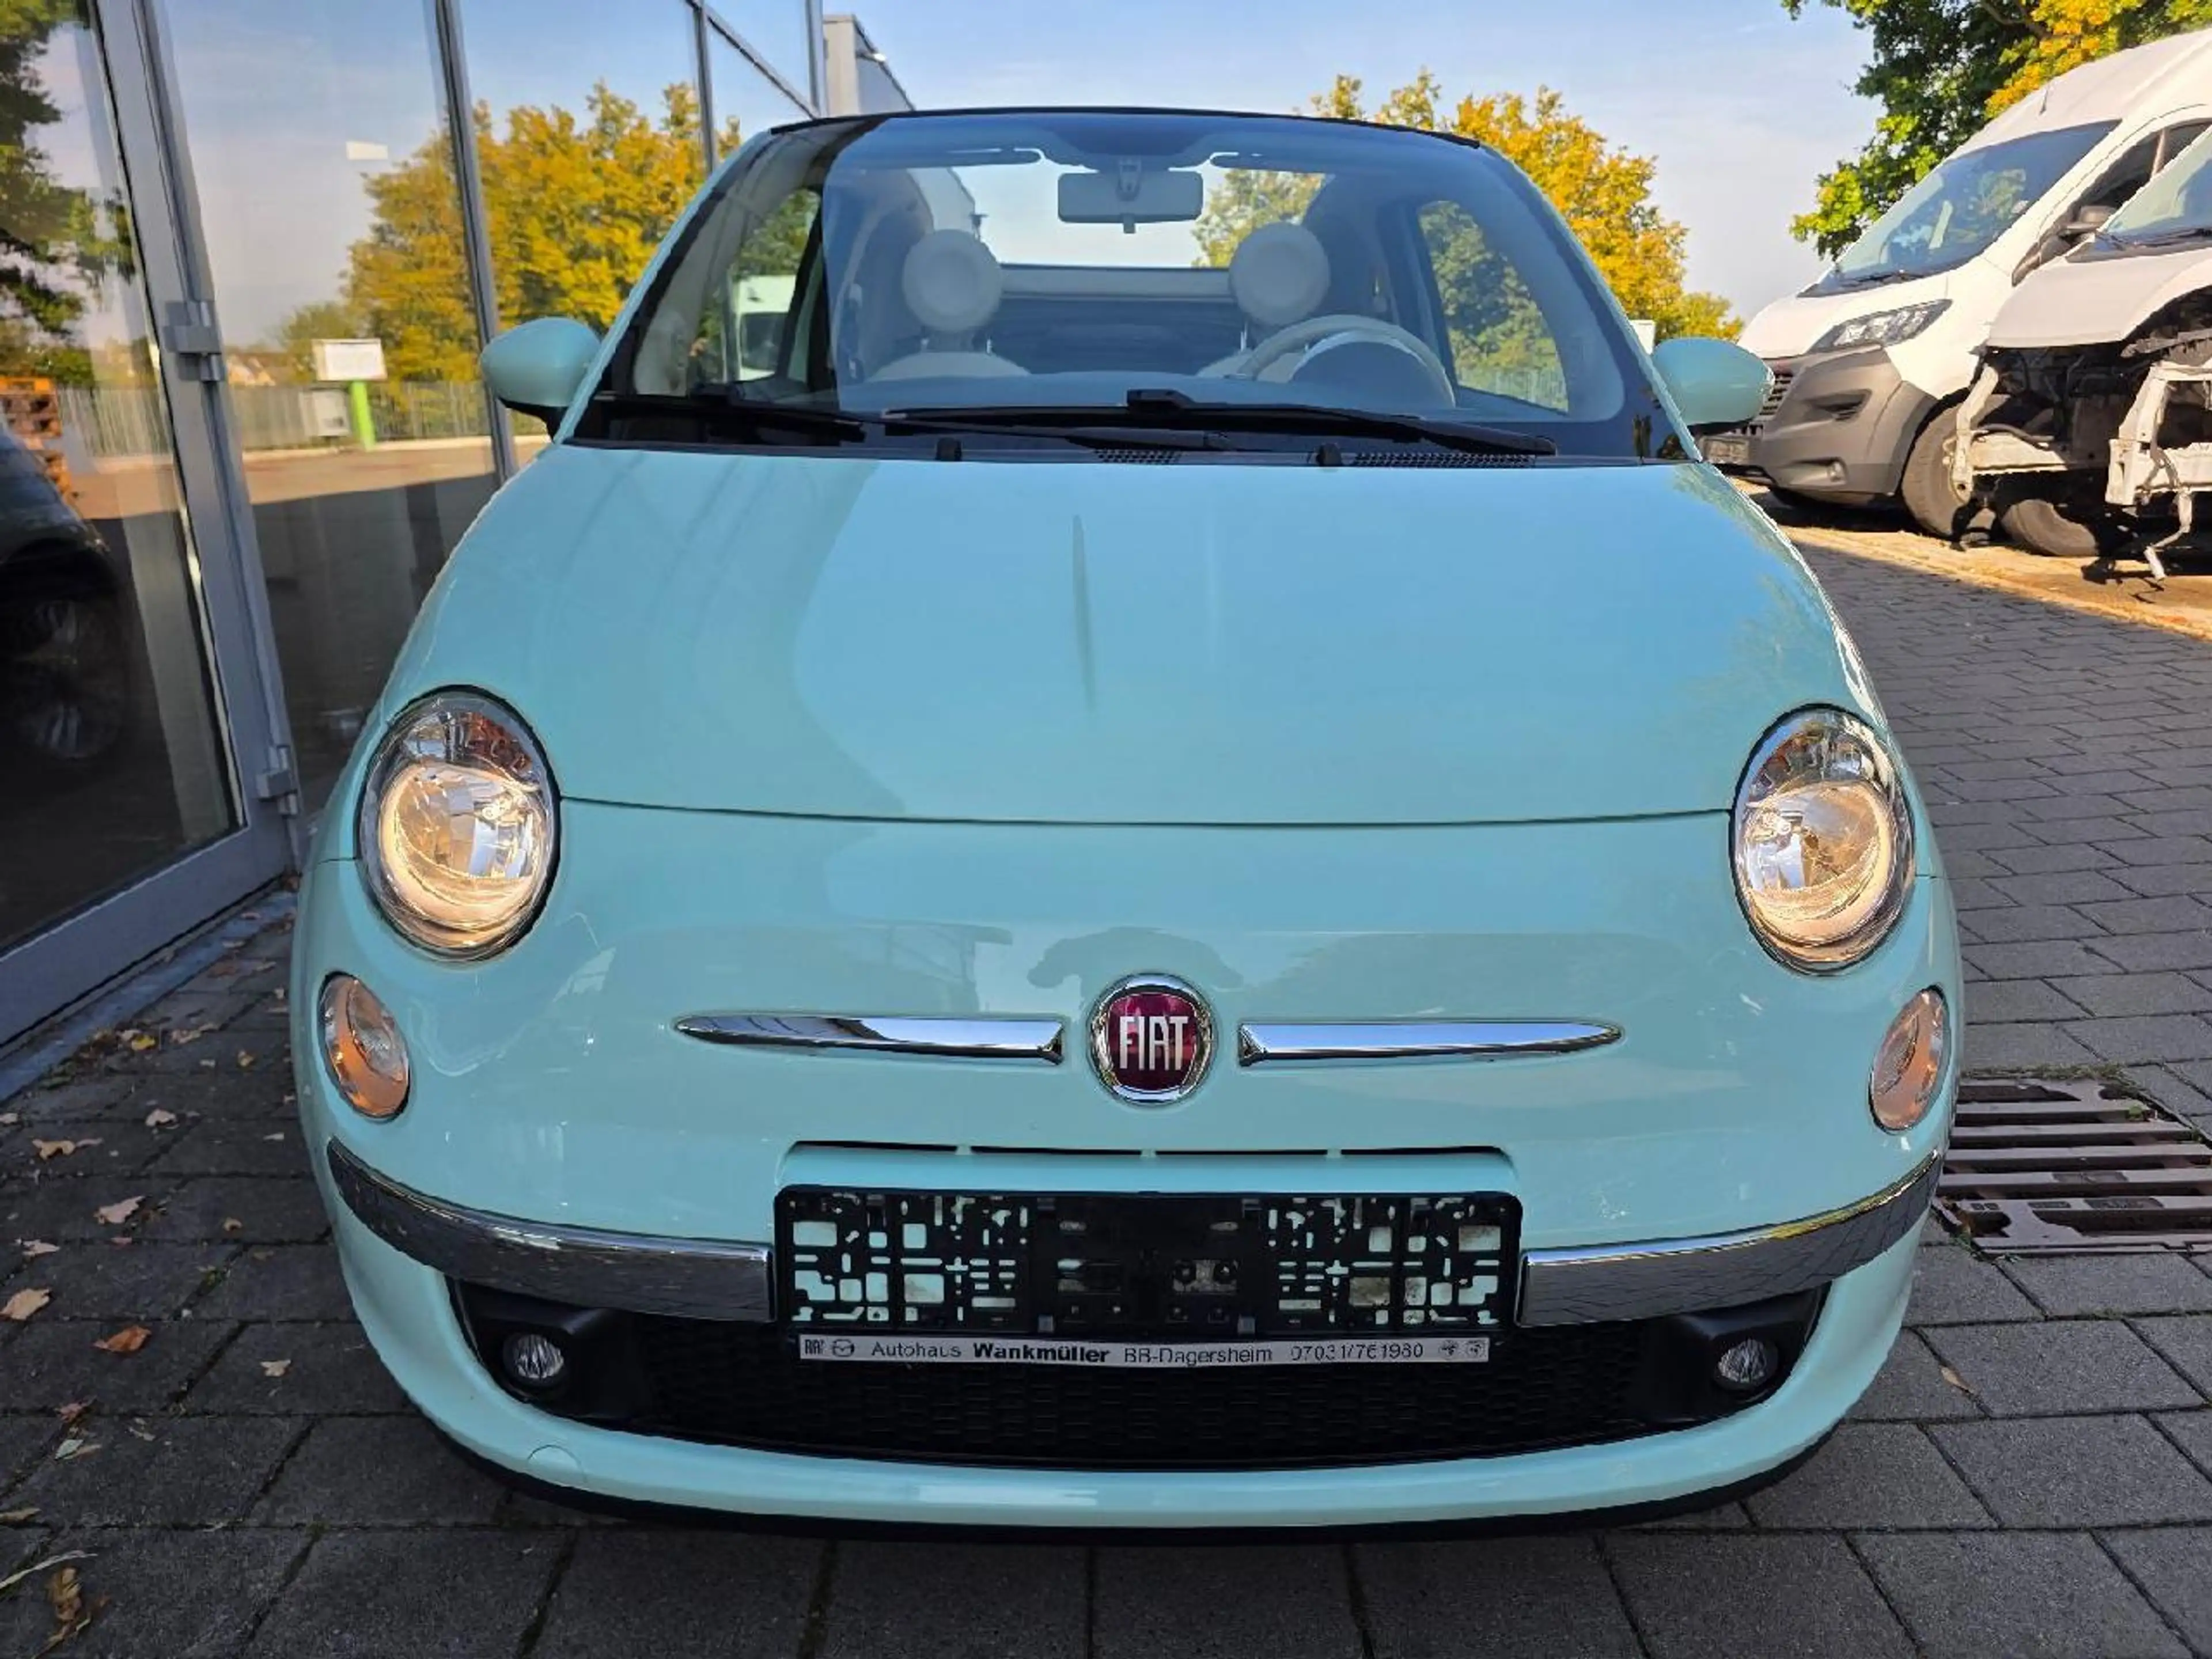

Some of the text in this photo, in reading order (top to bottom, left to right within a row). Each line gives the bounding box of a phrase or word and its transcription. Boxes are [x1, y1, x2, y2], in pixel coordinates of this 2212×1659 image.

[1119, 1016, 1189, 1071] FIAT
[870, 1341, 963, 1358] Autohaus
[973, 1342, 1111, 1362] Wankmüller
